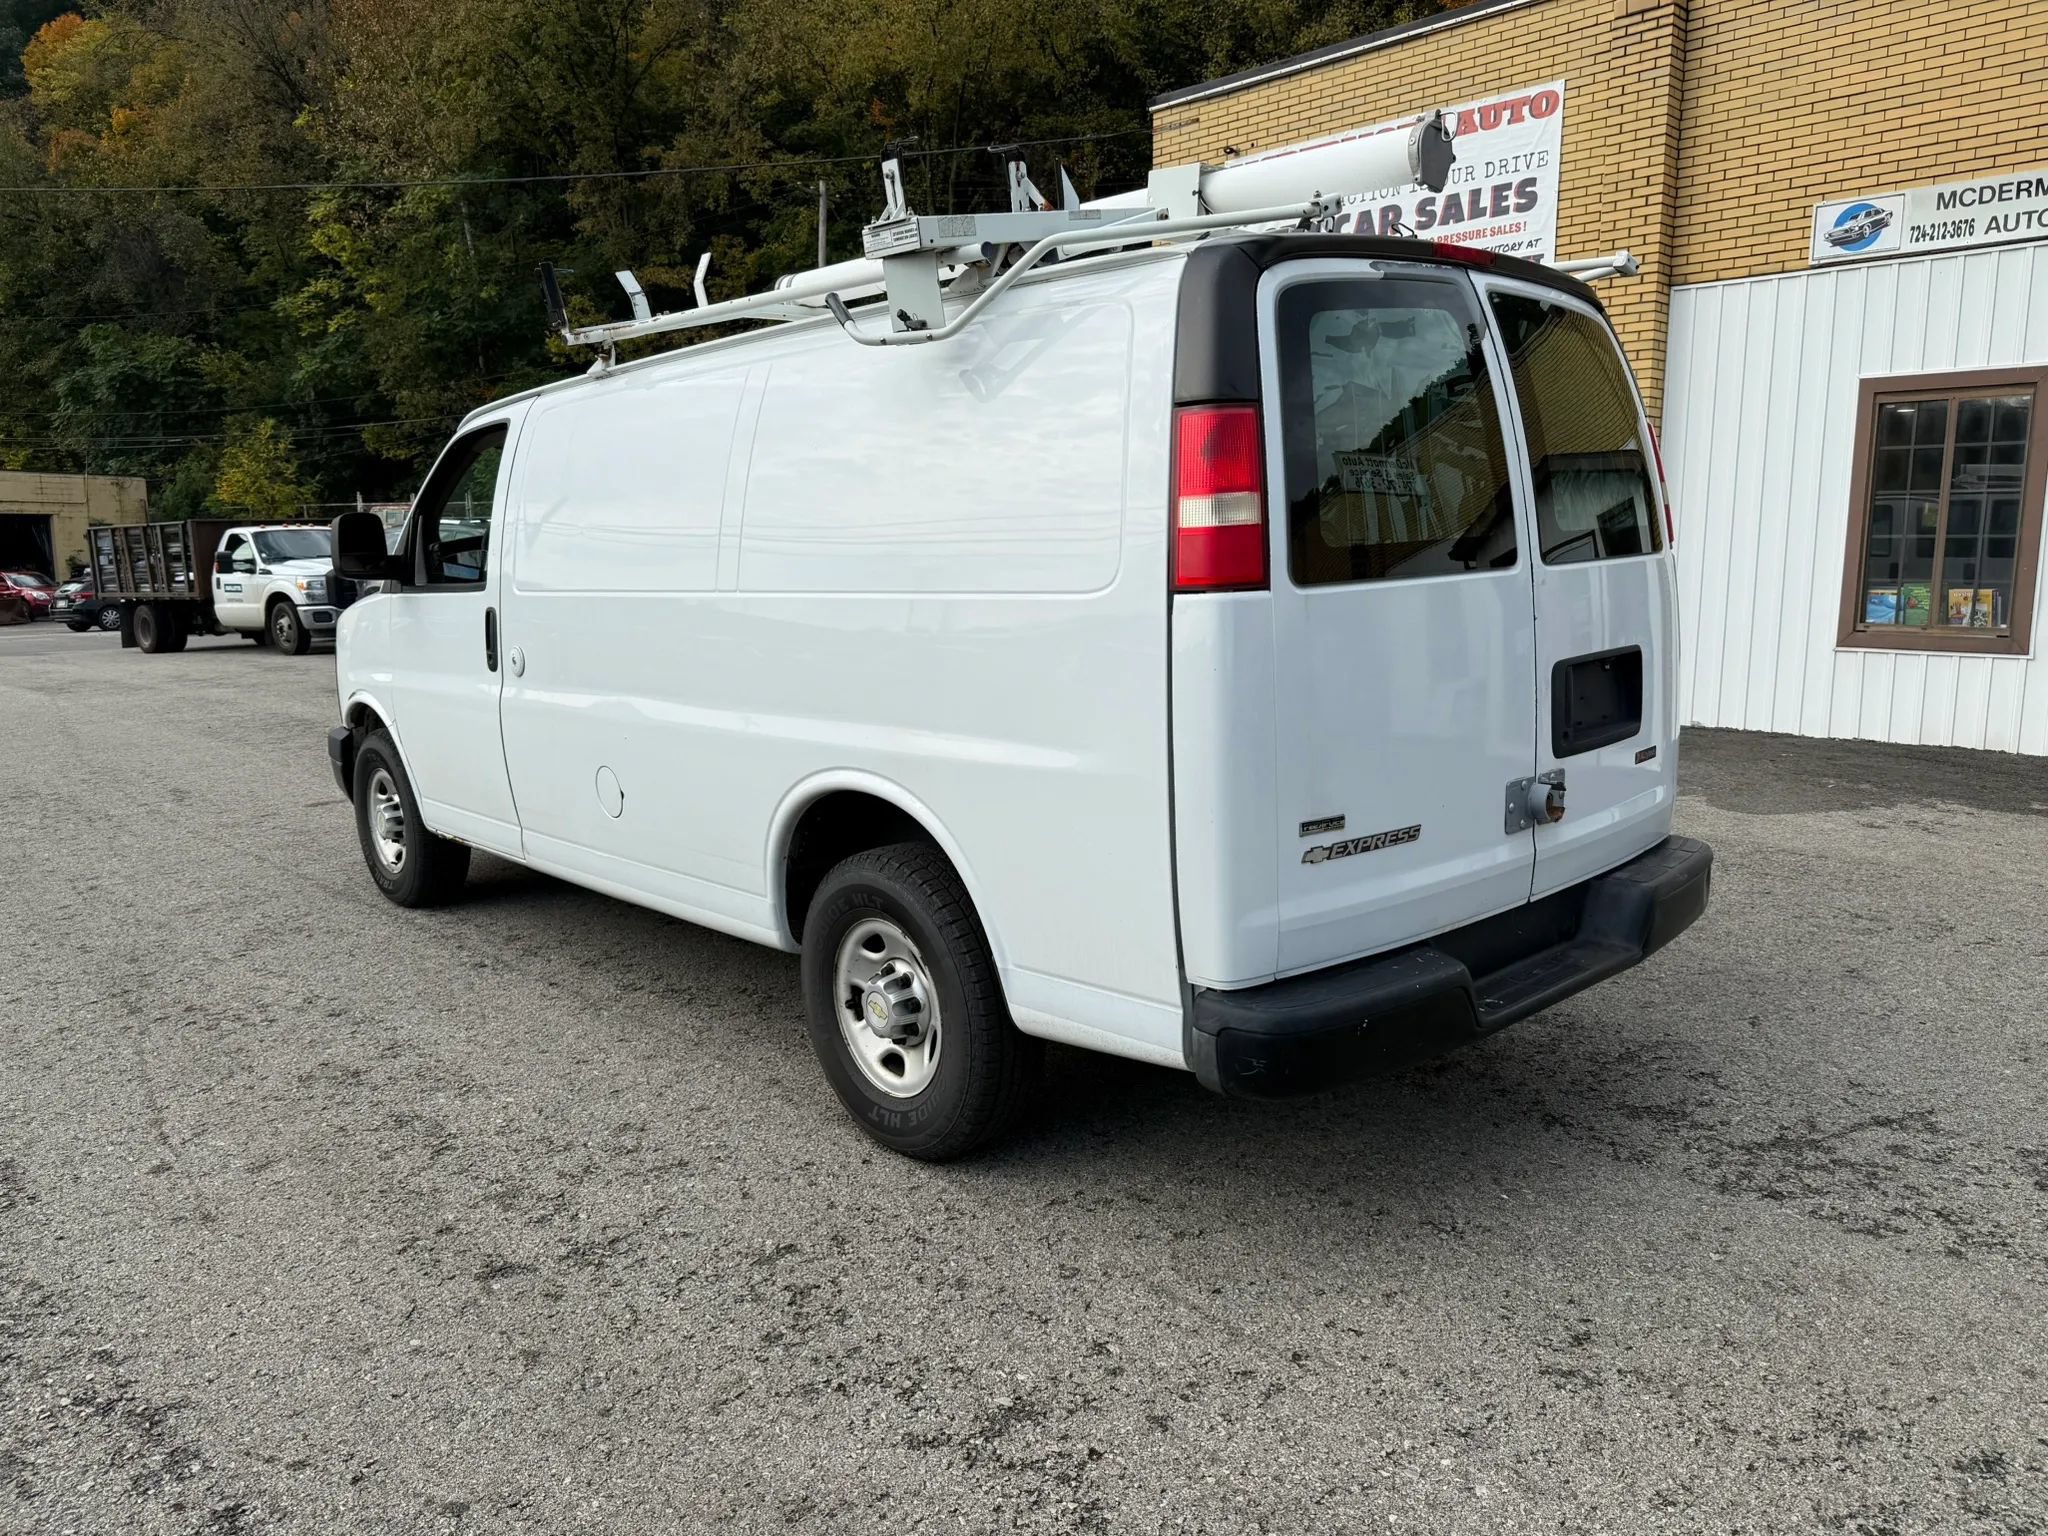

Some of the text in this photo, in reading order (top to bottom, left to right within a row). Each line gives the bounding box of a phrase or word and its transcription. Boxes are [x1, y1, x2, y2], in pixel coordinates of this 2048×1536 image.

[1456, 89, 1560, 136] AUTO
[1445, 165, 1476, 186] UR
[1484, 149, 1549, 179] DRIVE
[1413, 176, 1538, 231] SALES
[1437, 228, 1488, 245] PRESSURE
[1526, 238, 1543, 249] AT
[1909, 217, 1976, 243] 724-212-3676
[1329, 826, 1421, 860] EXPRESS
